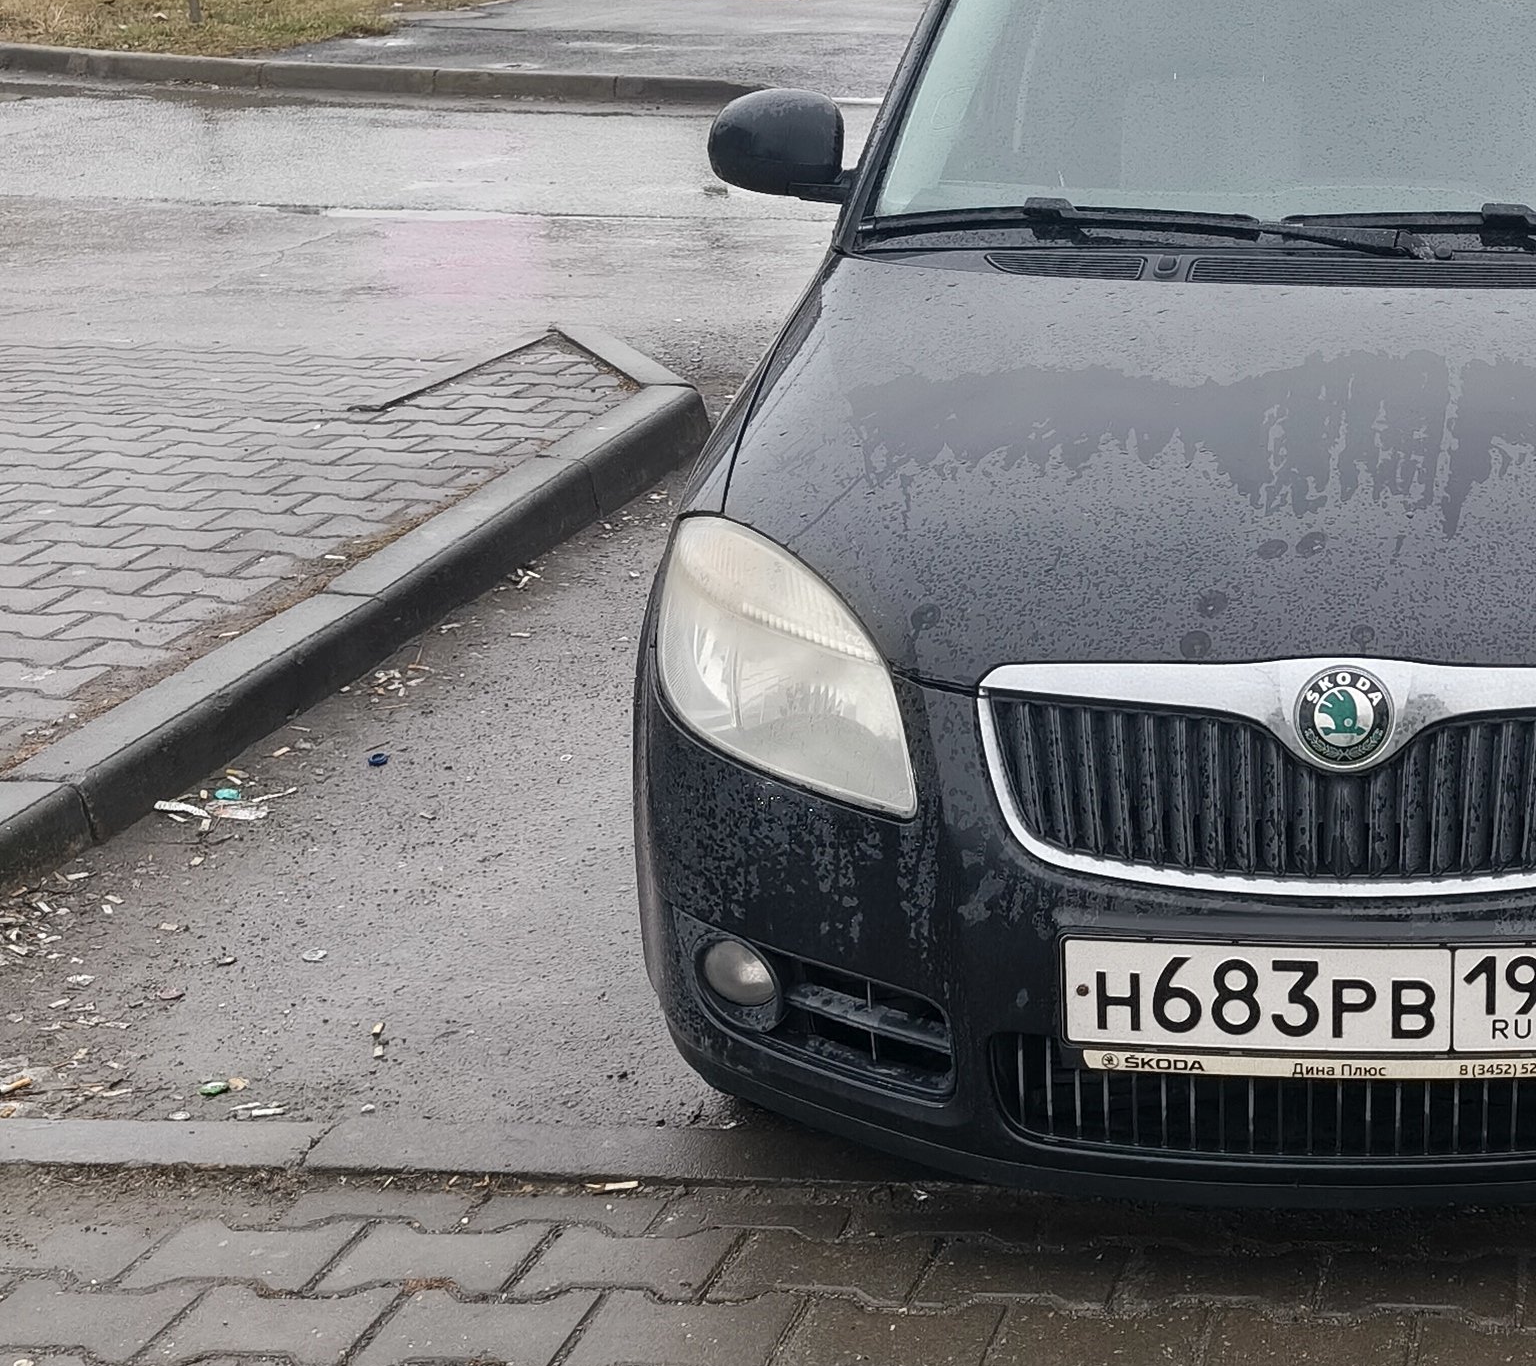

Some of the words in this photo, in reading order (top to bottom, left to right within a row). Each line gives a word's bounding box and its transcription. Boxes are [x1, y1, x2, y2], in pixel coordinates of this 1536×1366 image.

[1096, 956, 1436, 1040] Н683РВ
[1124, 1054, 1206, 1072] ŠKODA
[1292, 1062, 1336, 1078] Дина
[1341, 1063, 1387, 1077] Плюс
[1459, 1064, 1468, 1076] 8
[1472, 1063, 1518, 1078] (3452)
